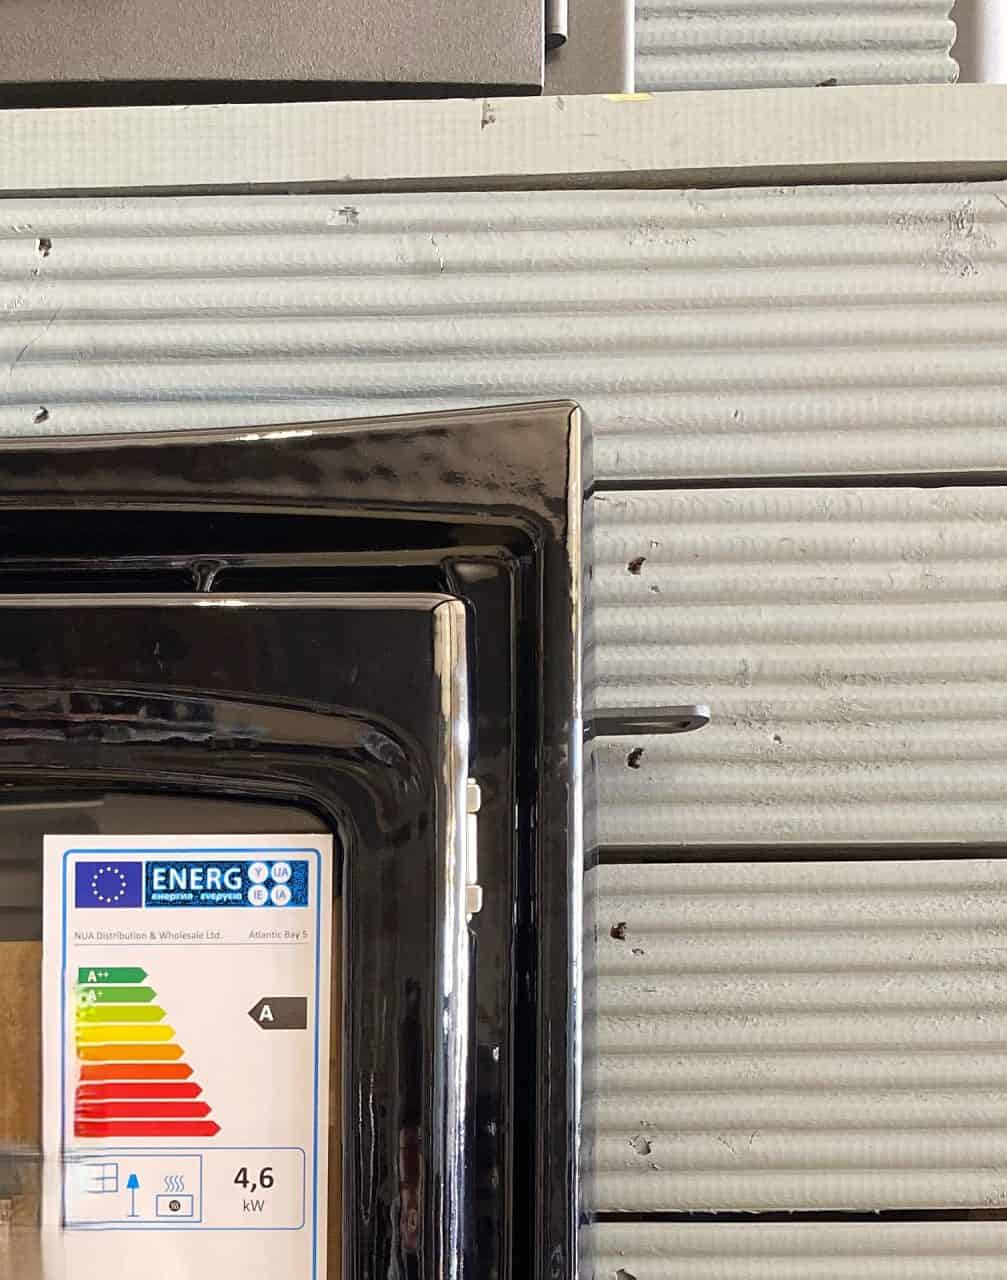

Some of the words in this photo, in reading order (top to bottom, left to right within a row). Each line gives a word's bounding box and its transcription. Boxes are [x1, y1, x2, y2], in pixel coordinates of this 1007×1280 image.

[253, 867, 263, 877] Y
[152, 867, 242, 890] ENERG
[75, 931, 94, 940] NUA
[97, 930, 147, 940] Distribution
[150, 931, 156, 940] &
[159, 930, 203, 940] Wholesale
[249, 929, 283, 938] Atlantic
[285, 930, 300, 940] Bay
[259, 1005, 275, 1021] A
[234, 1167, 274, 1192] 4,6
[243, 1200, 265, 1212] kW
